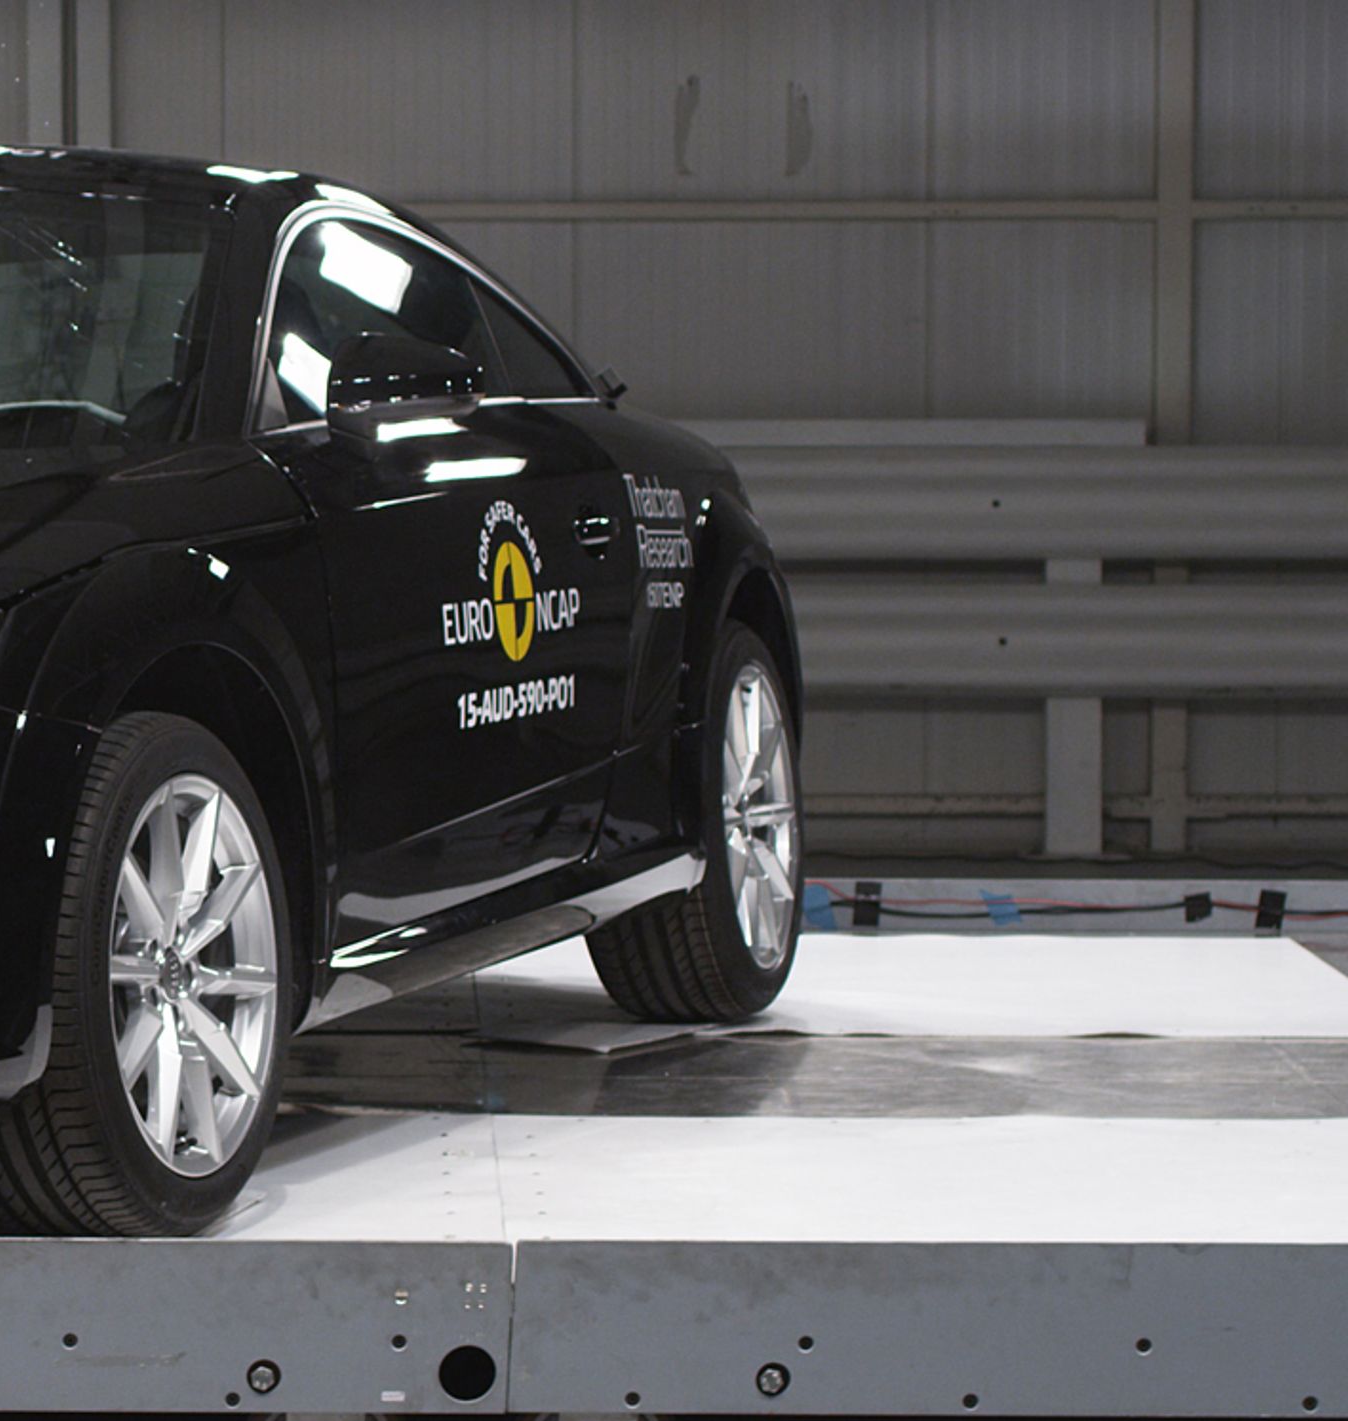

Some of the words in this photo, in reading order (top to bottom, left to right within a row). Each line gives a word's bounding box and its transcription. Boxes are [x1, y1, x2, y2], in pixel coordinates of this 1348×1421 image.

[484, 500, 515, 534] SAFER
[622, 473, 687, 519] Thatcham
[478, 528, 491, 582] FOR
[517, 514, 542, 575] CARS
[636, 523, 694, 569] Research
[442, 598, 494, 646] EURO
[536, 587, 580, 632] NCAP
[457, 674, 576, 730] 15-AUD-590-P01
